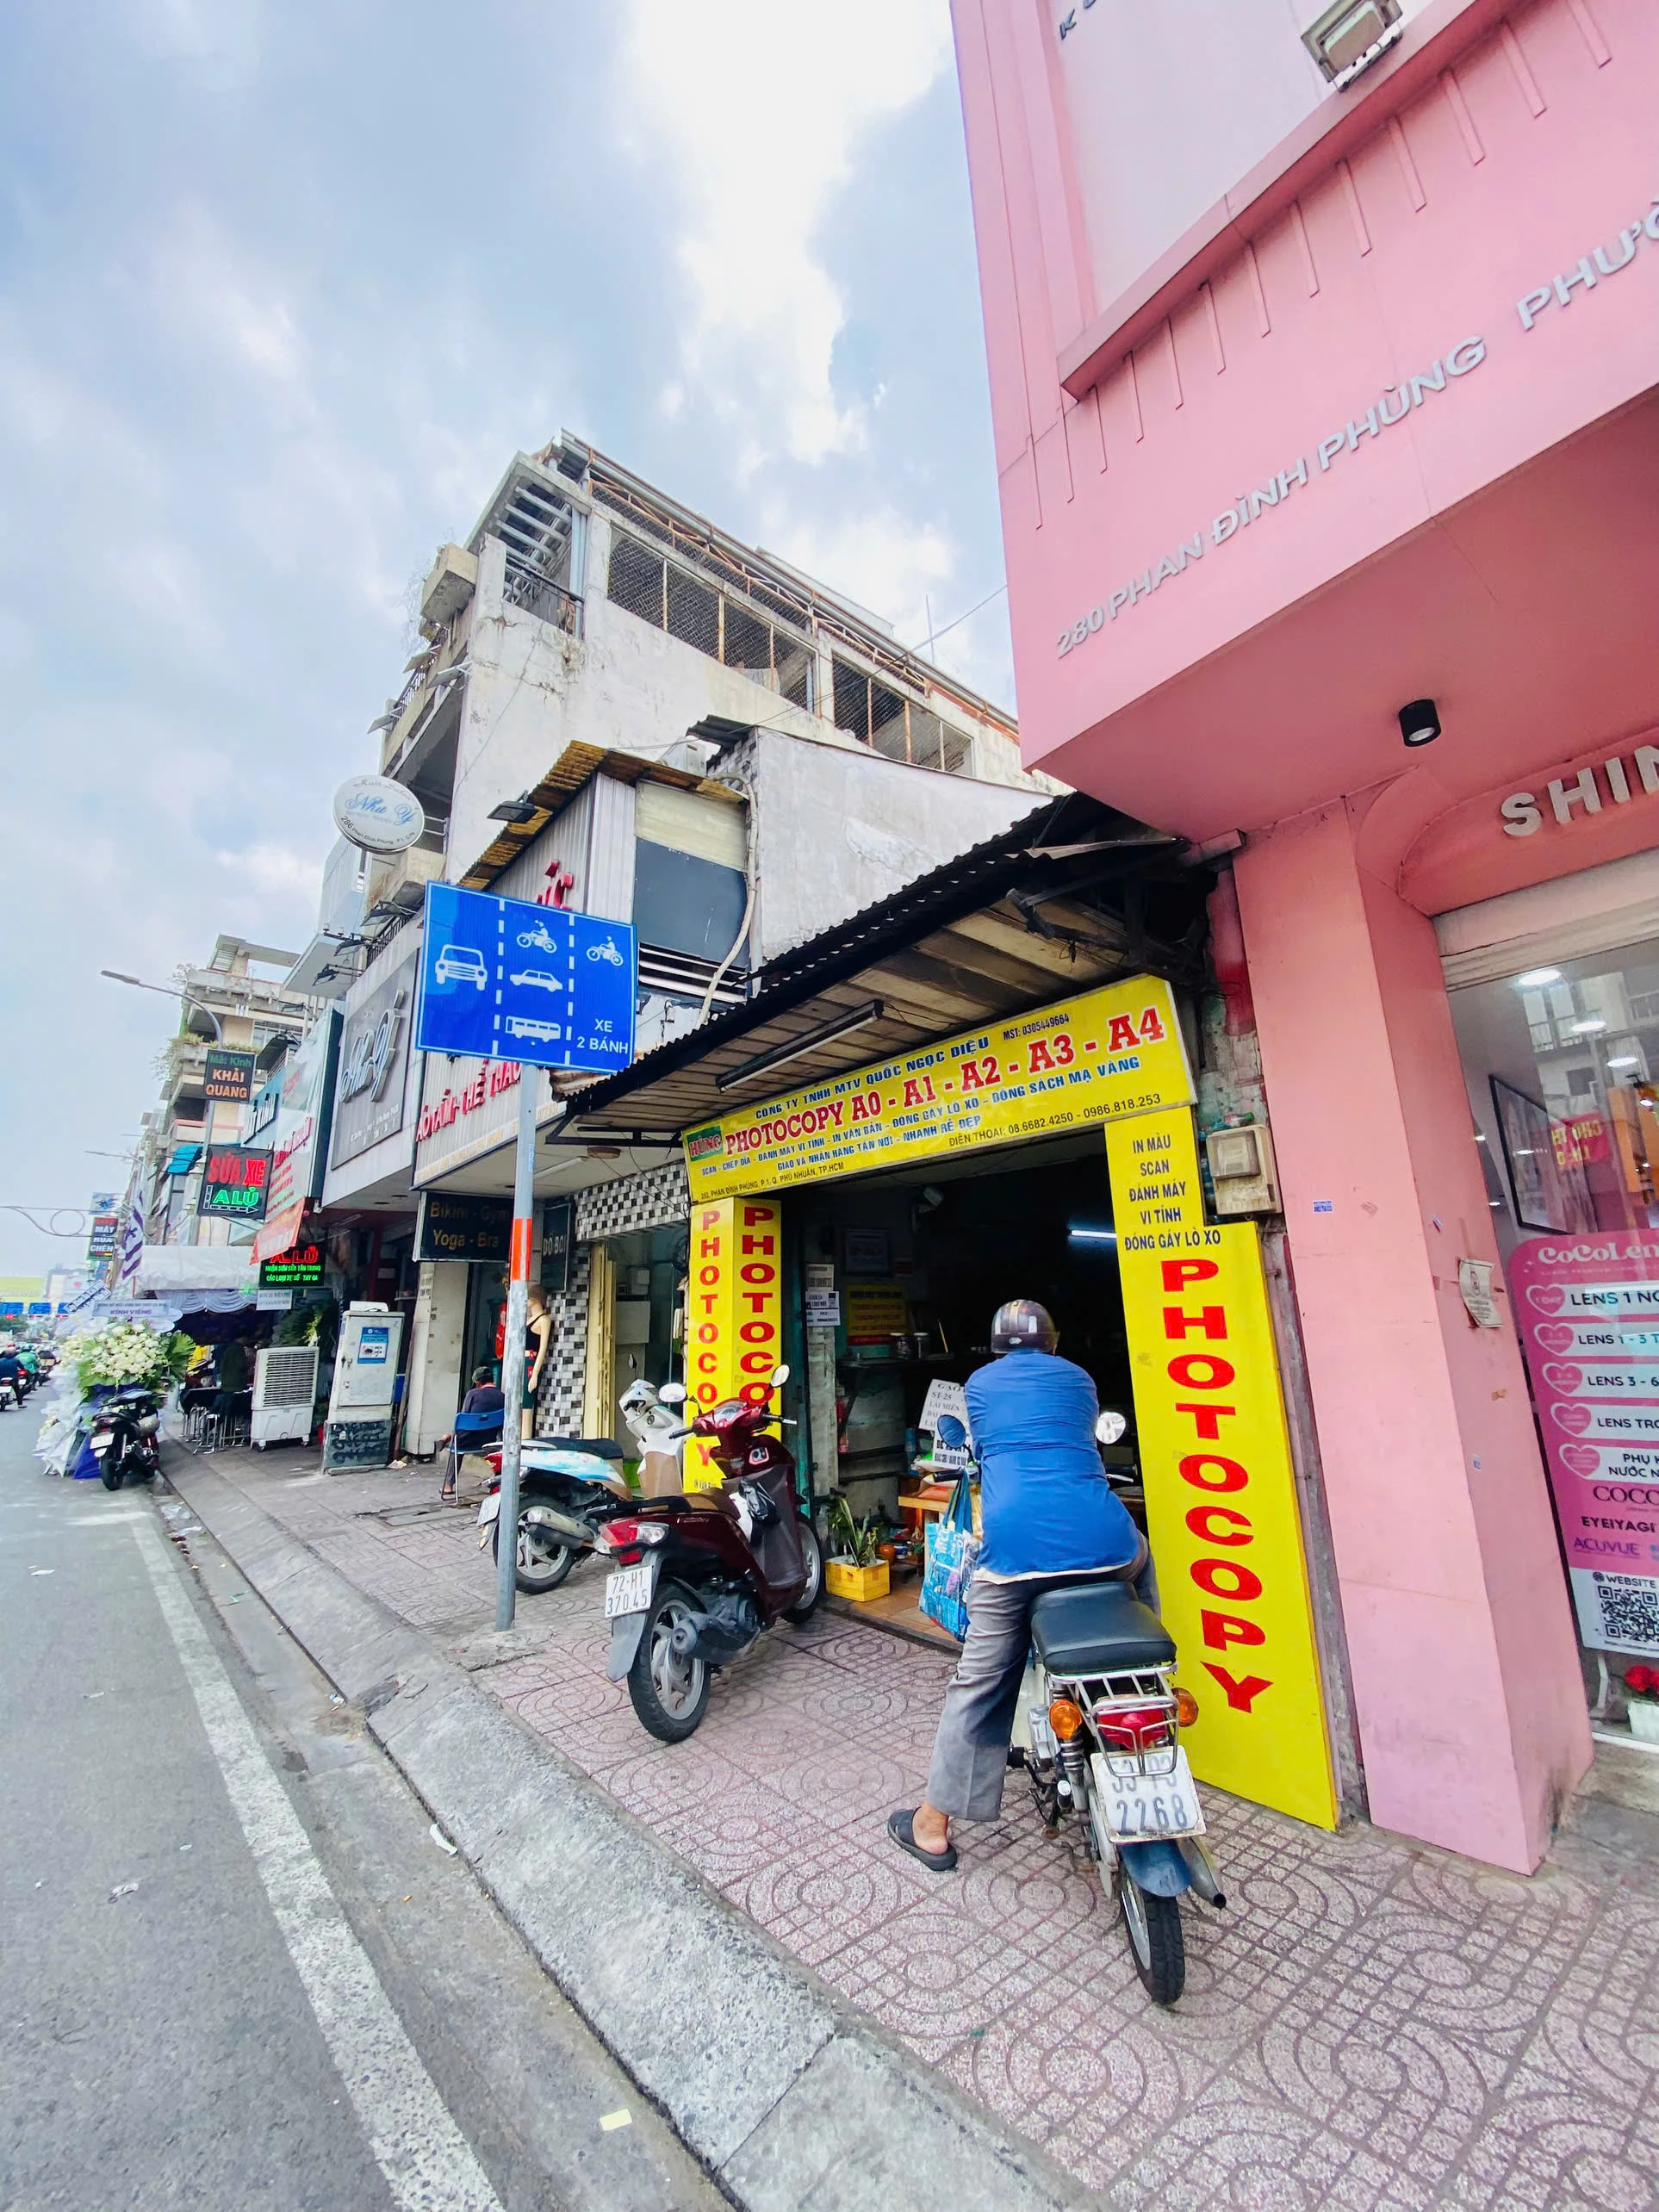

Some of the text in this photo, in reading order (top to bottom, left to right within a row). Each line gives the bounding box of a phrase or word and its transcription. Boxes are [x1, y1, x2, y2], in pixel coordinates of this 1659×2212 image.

[1055, 608, 1105, 659] 280
[1107, 532, 1205, 618] PHAN
[1210, 457, 1309, 546] ĐÌNH
[1317, 334, 1488, 471] PHÙNG
[340, 816, 354, 830] 286
[593, 1018, 613, 1034] XE
[576, 1036, 629, 1054] 2 BÁNH
[229, 1053, 252, 1067] Kính
[786, 1098, 798, 1109] TY
[803, 1088, 830, 1103] TNHH
[835, 1078, 861, 1094] MTV
[866, 1065, 901, 1085] QUỐC
[906, 1052, 945, 1072] NGỌC
[1003, 1028, 1021, 1041] MST:
[1022, 1013, 1069, 1035] 0305449664
[212, 1066, 245, 1083] KHẢI
[724, 1007, 1165, 1155] PHOTOCOPY A0 A1 A2 A3 A4
[206, 1084, 248, 1099] QUANG
[702, 1165, 717, 1176] SCAN
[798, 1143, 805, 1152] VI
[832, 1133, 842, 1143] IN
[964, 1097, 979, 1110] XO
[1028, 1074, 1065, 1095] SÁCH
[1068, 1068, 1092, 1084] MẠ
[1097, 1055, 1140, 1077] VÀNG
[1008, 1111, 1074, 1134] 08.6682.4250
[1083, 1093, 1161, 1118] 0986.818.253
[777, 1159, 795, 1171] GIAO
[903, 1125, 938, 1142] NHANH
[958, 1115, 981, 1131] ĐẸP
[1132, 1133, 1172, 1154] IN MÀU
[242, 1159, 267, 1187] XE
[1140, 1159, 1170, 1177] SCAN
[711, 1187, 725, 1197] PHAN
[818, 1161, 844, 1175] TP.HCM
[1128, 1177, 1186, 1202] ĐÁNH MÁY
[1140, 1204, 1182, 1225] VI TÍNH
[433, 1229, 500, 1251] Yoga Bra
[1124, 1227, 1221, 1251] ĐÓNG GÁY LÒ XO
[738, 1206, 777, 1405] PHOTOCO
[1570, 1292, 1619, 1306] LENS
[1623, 1291, 1631, 1303] 1
[695, 1209, 721, 1467] PHOTOCOY
[1578, 1334, 1614, 1345] LENS
[1619, 1334, 1625, 1345] 1
[1588, 1376, 1624, 1387] LENS
[1627, 1376, 1636, 1387] 3
[1597, 1417, 1632, 1428] LENS
[1623, 1453, 1650, 1465] PHỤ
[1160, 1258, 1275, 1714] PHOTOCOPY
[1574, 1537, 1641, 1556] ACUVUE
[1606, 1574, 1657, 1589] WEBSITE
[606, 1588, 648, 1615] 370.45
[1116, 1793, 1189, 1836] 2268
